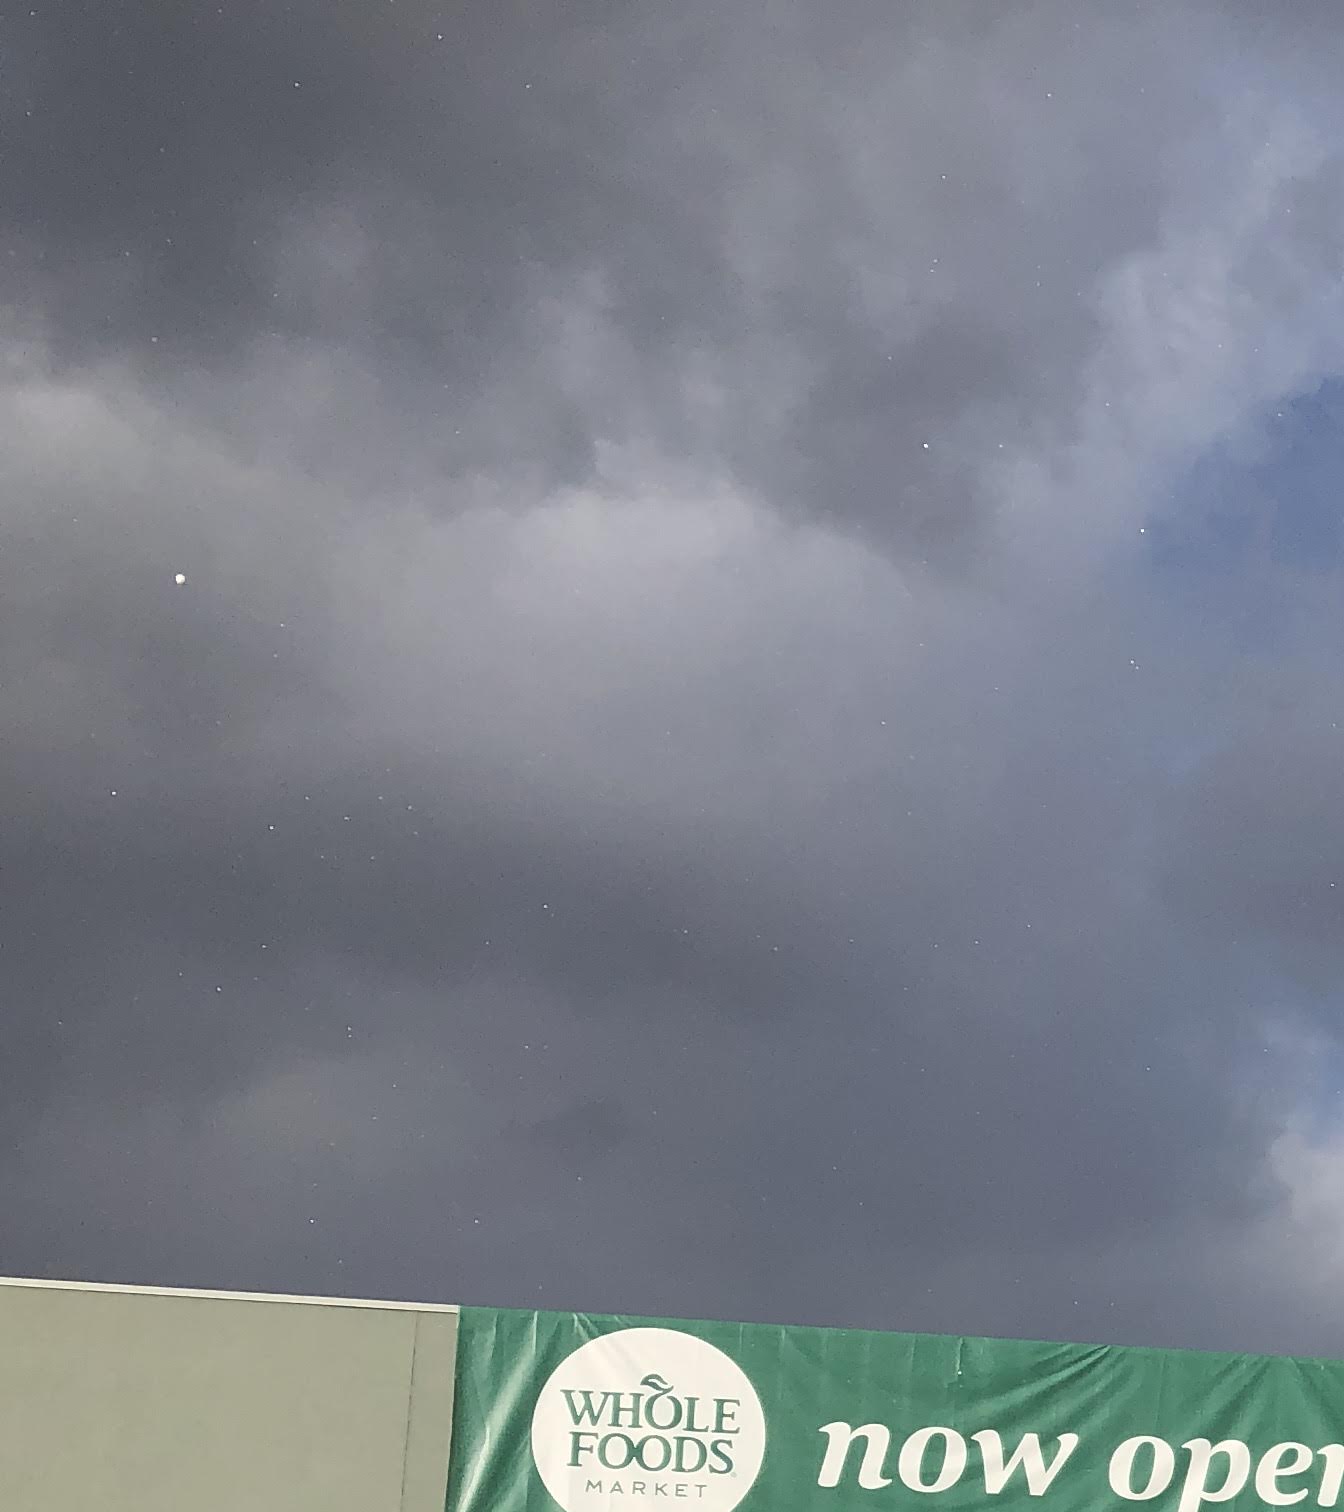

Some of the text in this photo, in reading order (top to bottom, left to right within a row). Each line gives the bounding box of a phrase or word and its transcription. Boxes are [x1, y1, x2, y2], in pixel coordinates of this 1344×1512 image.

[560, 1381, 741, 1434] WHOLE
[567, 1431, 734, 1475] FOODS
[818, 1421, 1078, 1496] now
[585, 1479, 708, 1498] MARKET
